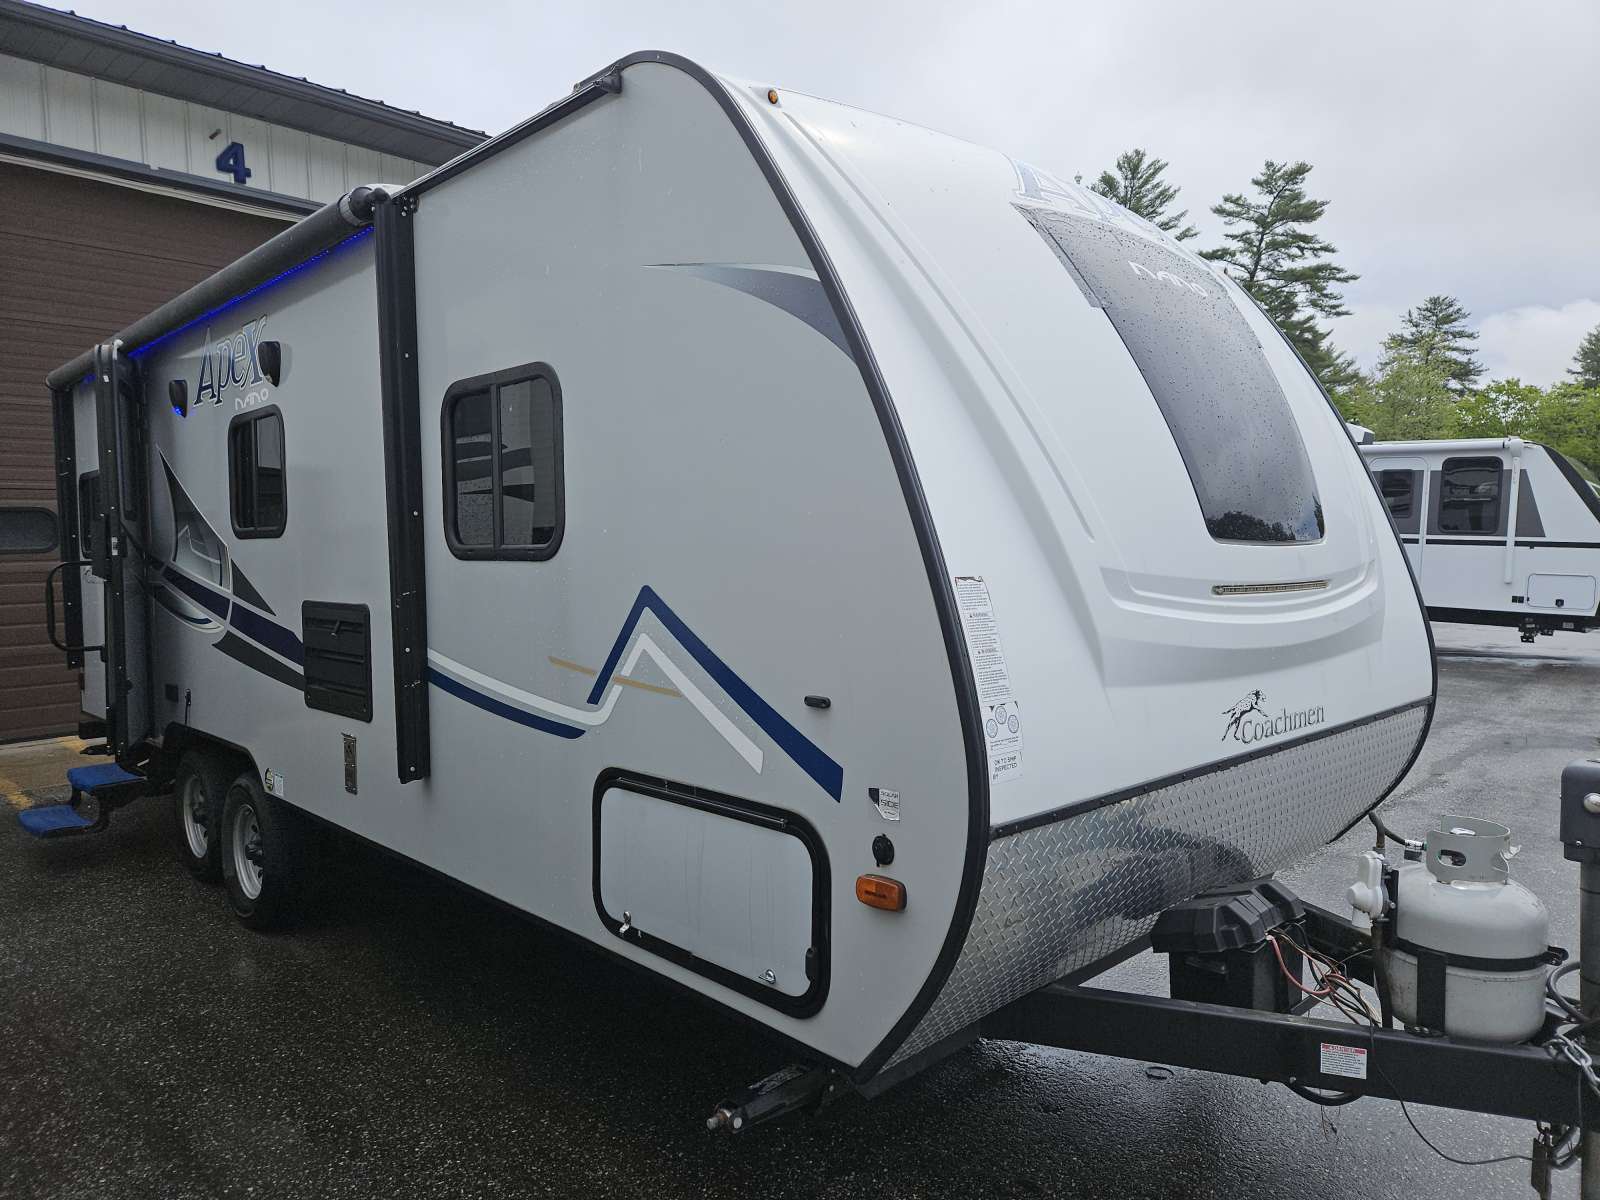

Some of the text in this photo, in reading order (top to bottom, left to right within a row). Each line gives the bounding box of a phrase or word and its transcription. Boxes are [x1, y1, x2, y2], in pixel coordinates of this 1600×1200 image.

[216, 142, 252, 184] 4
[1241, 705, 1325, 744] Coachmen
[880, 798, 899, 809] SIDE
